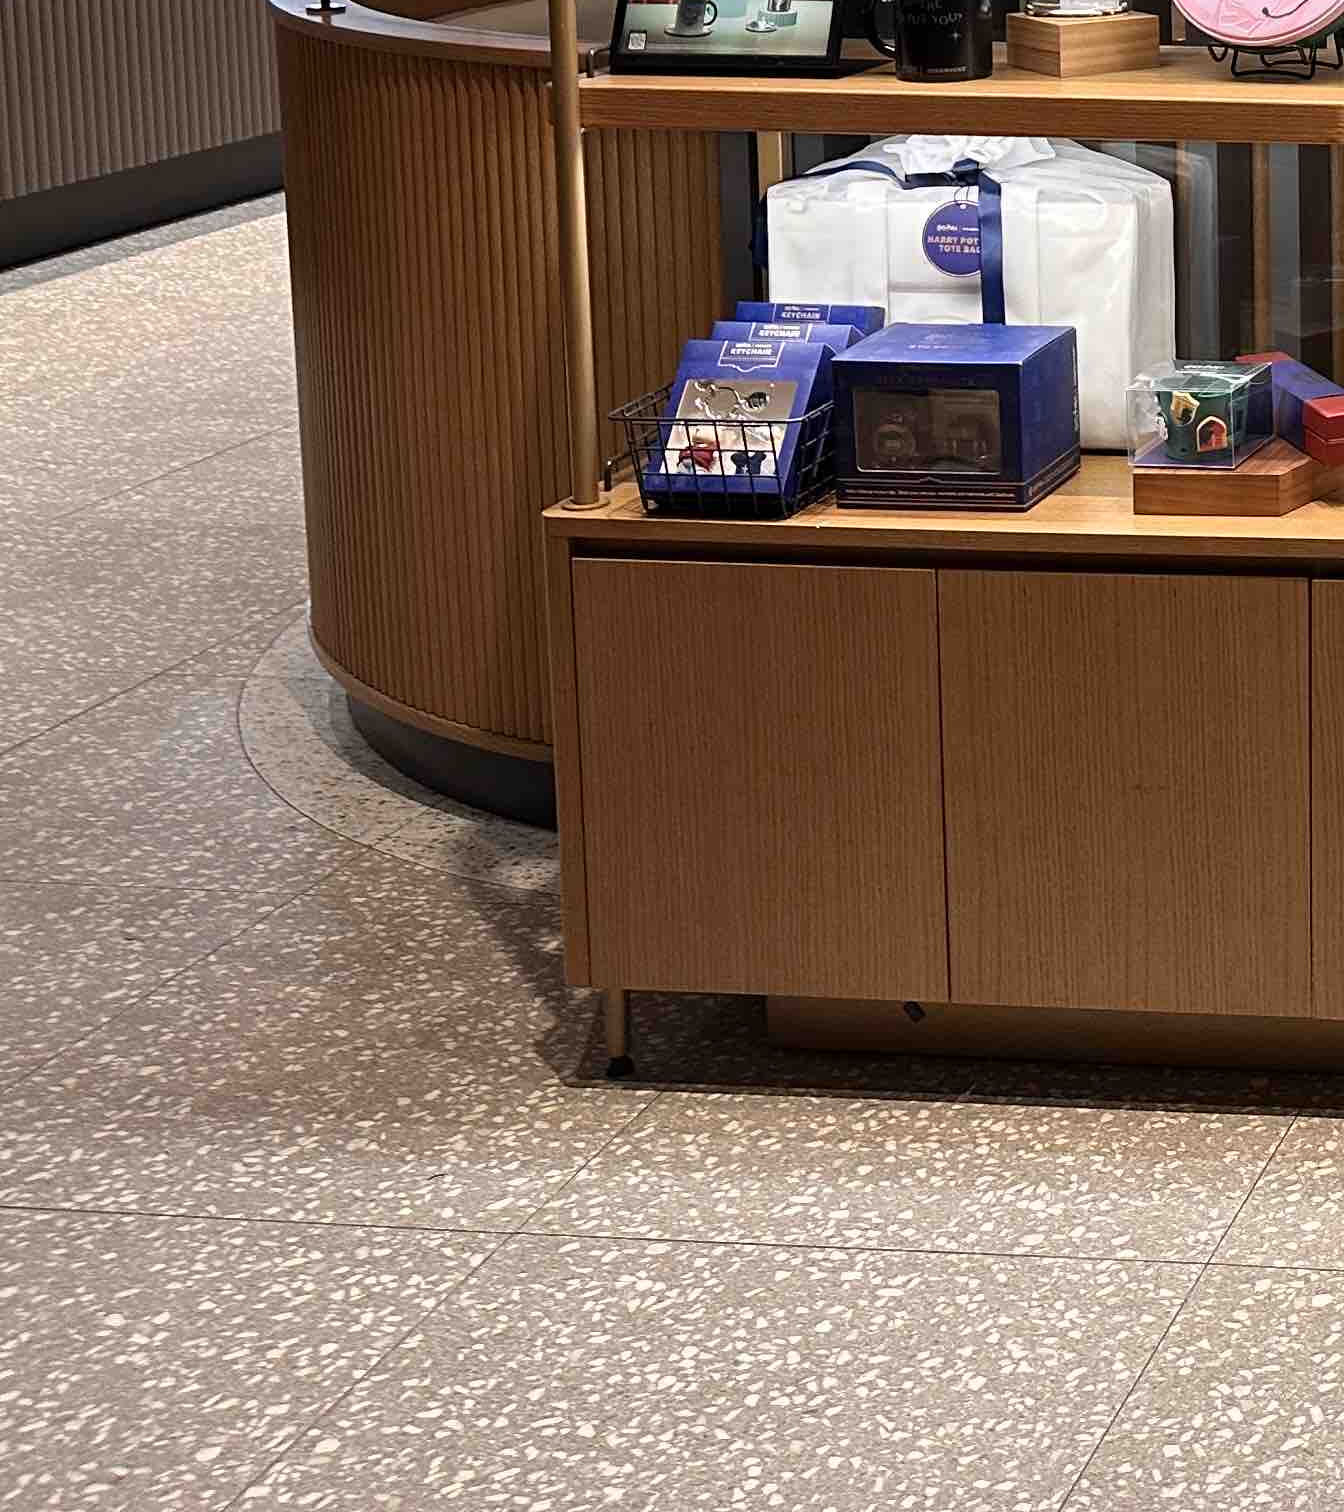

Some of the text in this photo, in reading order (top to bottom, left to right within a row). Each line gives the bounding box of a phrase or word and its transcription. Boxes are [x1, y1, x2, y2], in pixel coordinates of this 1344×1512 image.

[927, 235, 959, 244] HARRY
[938, 244, 962, 253] TOTE
[781, 311, 822, 320] KEYCHAIN
[757, 329, 801, 338] KEYCHAIN
[730, 348, 773, 356] KEYCHAIN
